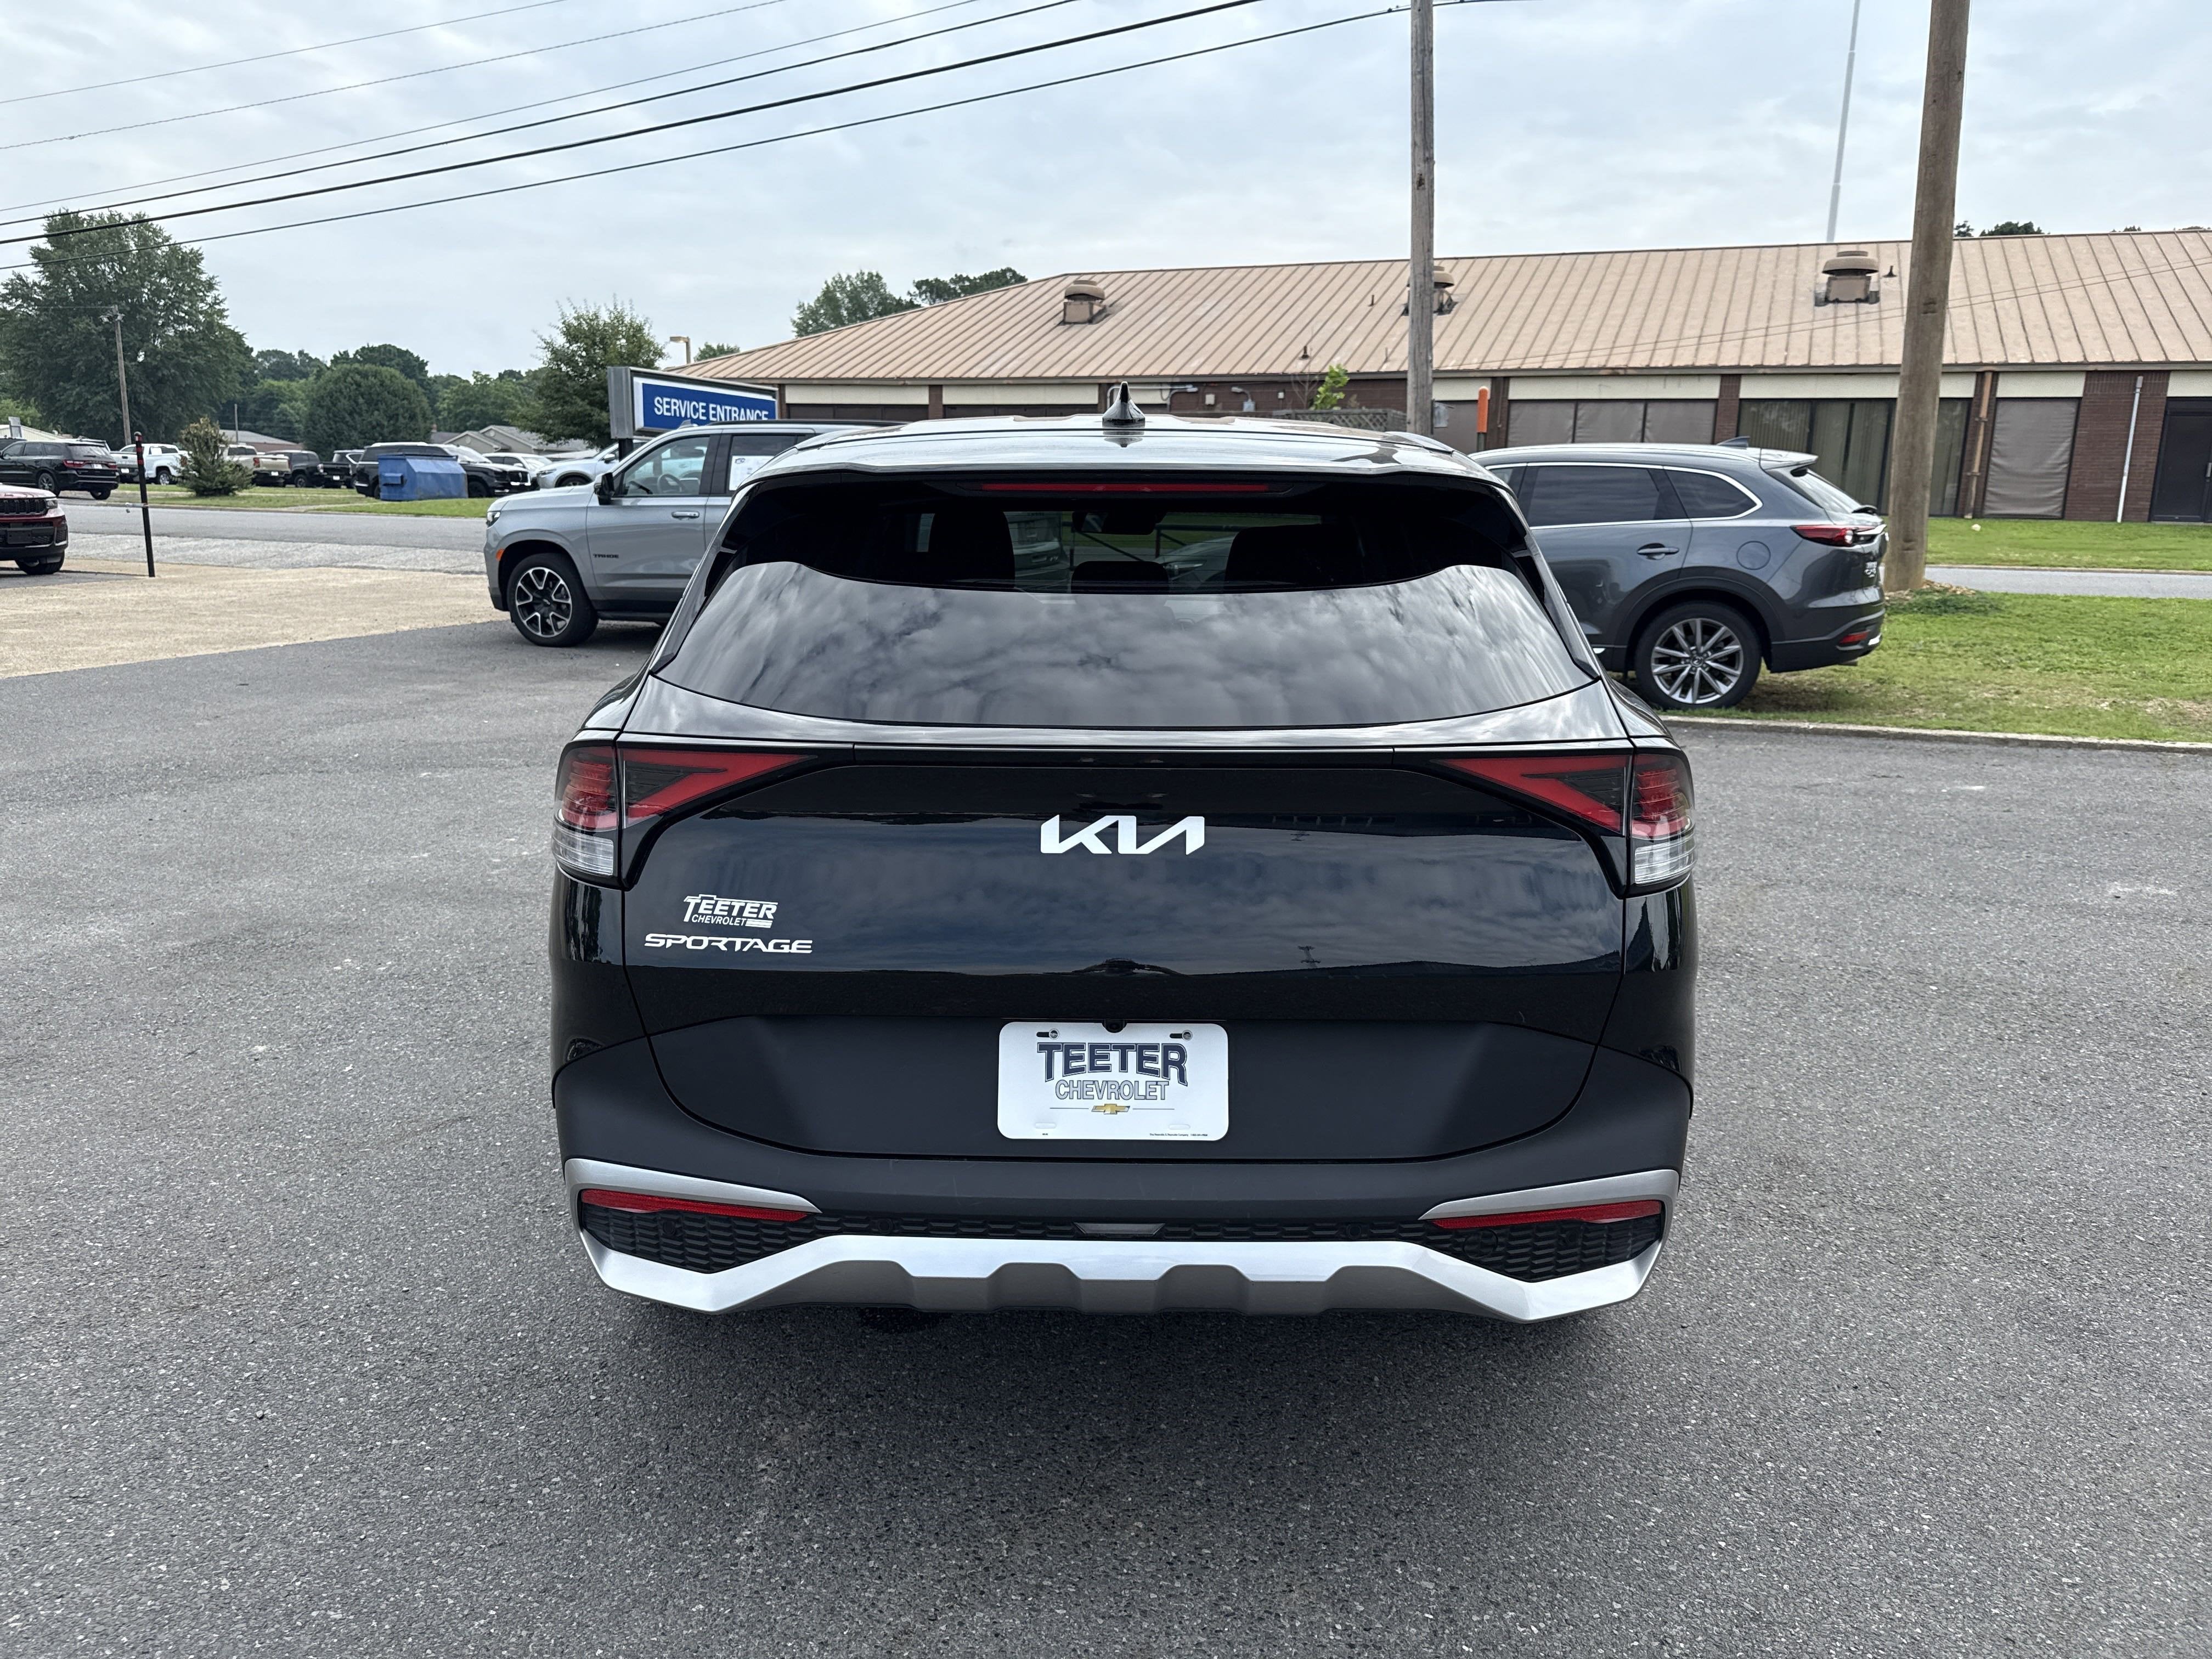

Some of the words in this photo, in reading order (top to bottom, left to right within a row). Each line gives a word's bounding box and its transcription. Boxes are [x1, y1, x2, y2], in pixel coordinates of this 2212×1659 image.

[654, 397, 707, 420] SERVICE
[709, 403, 769, 421] ENTRANCE
[1041, 814, 1205, 855] KIA
[684, 898, 777, 922] TEETER
[691, 914, 747, 926] CHEVROLET
[644, 933, 813, 953] SPORTAGE
[1036, 1042, 1188, 1087] TEETER
[1055, 1080, 1170, 1101] CHEVROLET
